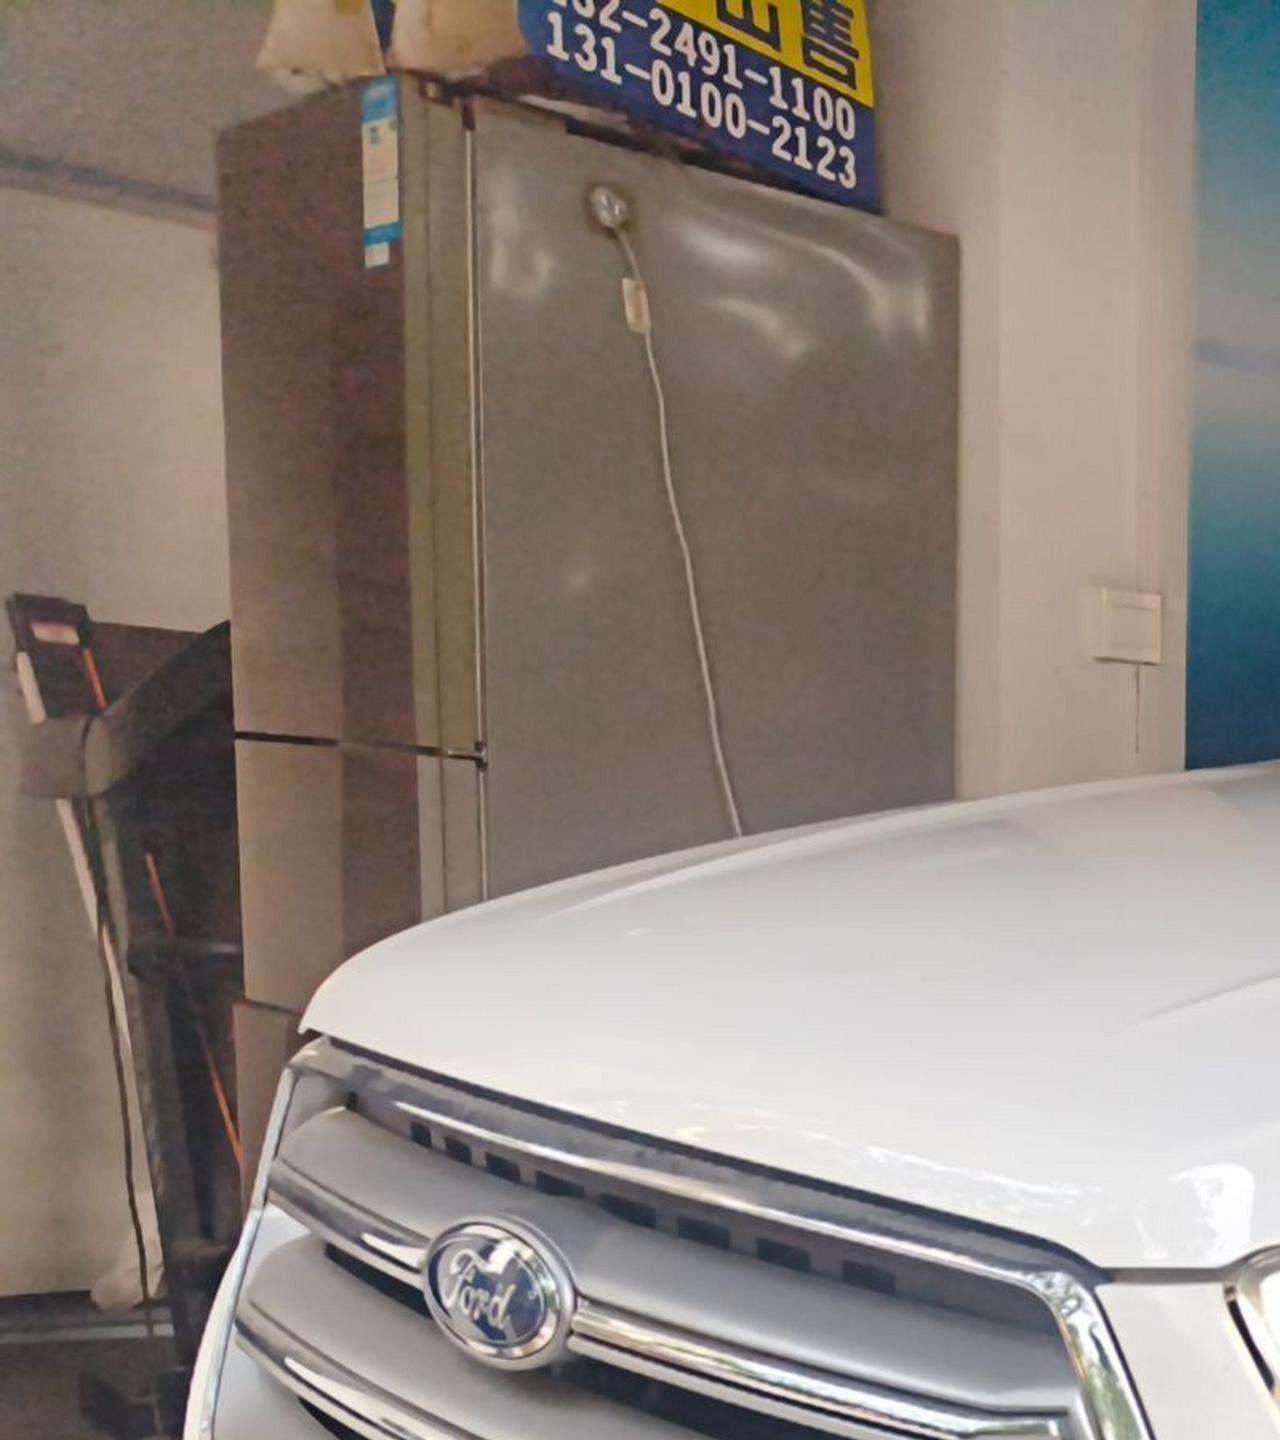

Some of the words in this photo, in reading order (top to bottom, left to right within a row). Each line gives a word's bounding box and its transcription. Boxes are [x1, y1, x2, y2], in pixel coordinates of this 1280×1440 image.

[547, 11, 857, 189] 131-0100-2123
[551, 0, 855, 140] 2-2491-1100
[442, 1247, 526, 1332] Ford
